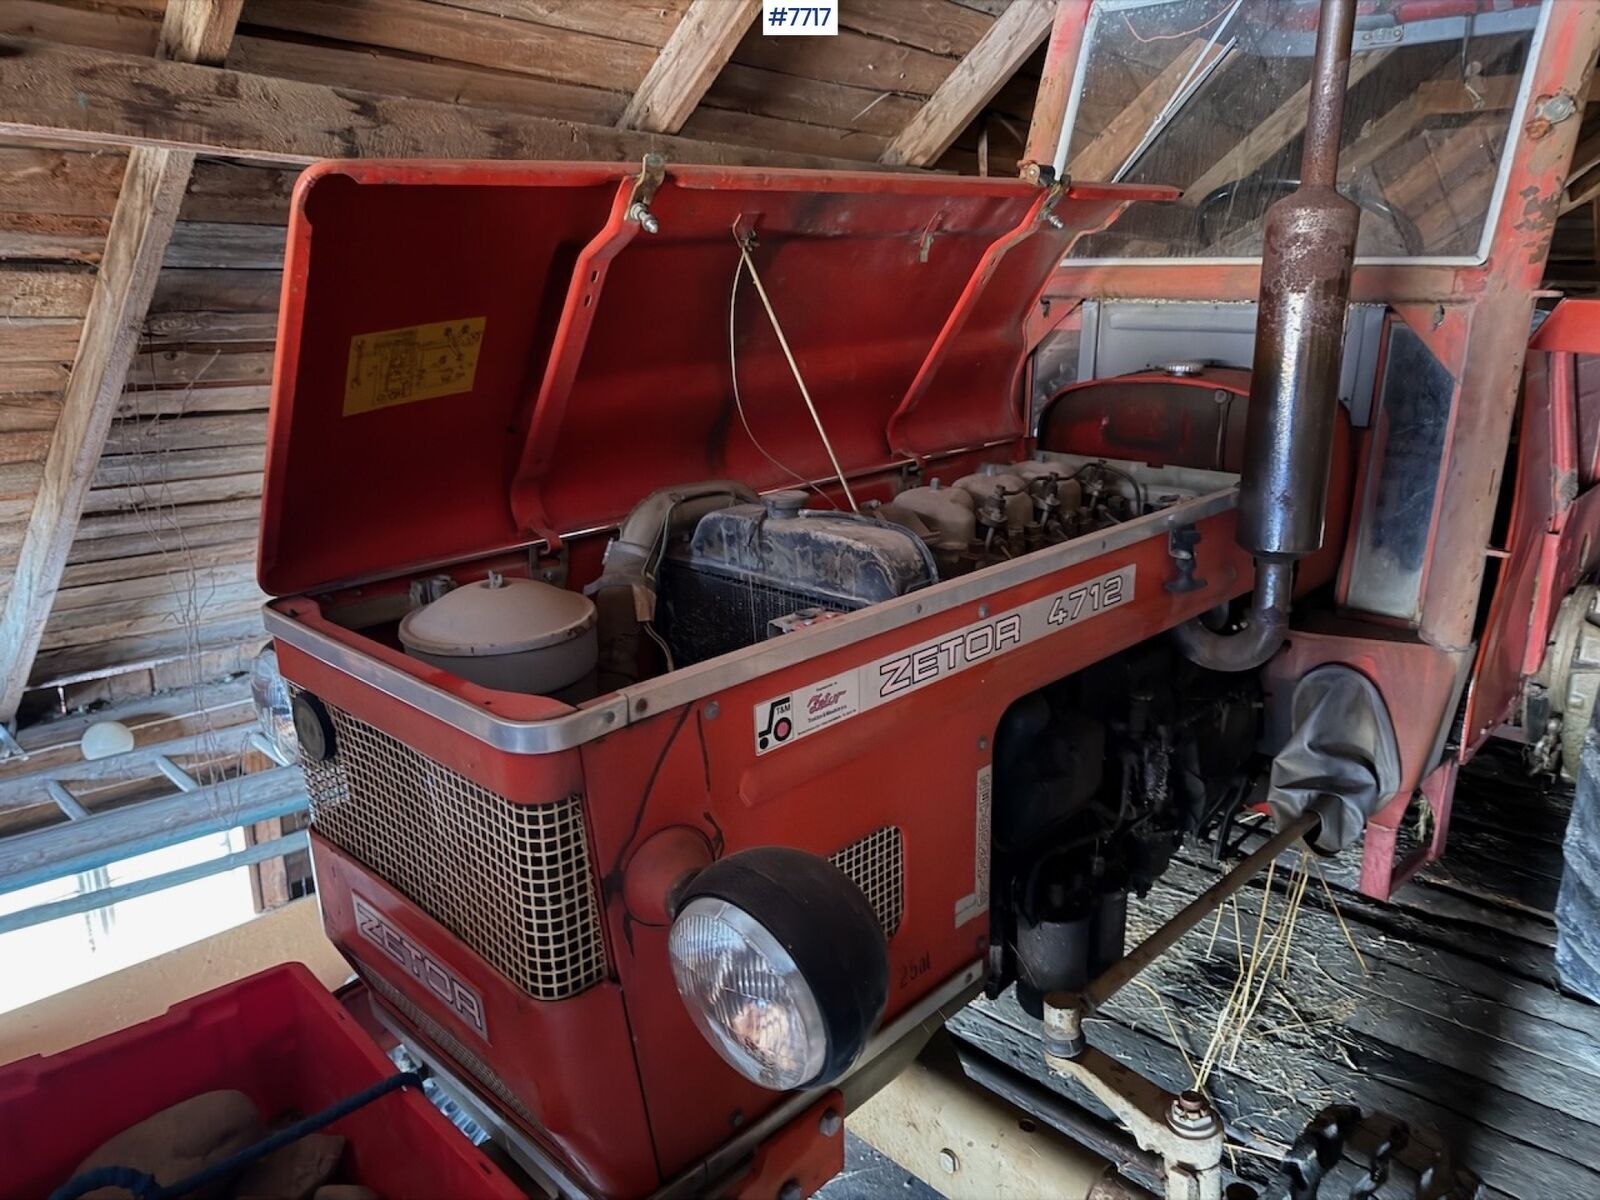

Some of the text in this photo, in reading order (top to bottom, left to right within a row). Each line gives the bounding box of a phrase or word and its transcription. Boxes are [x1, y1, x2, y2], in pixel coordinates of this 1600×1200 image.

[879, 575, 1123, 697] ZETOR 4712
[775, 703, 791, 715] T&M
[356, 902, 483, 1031] ZETOR
